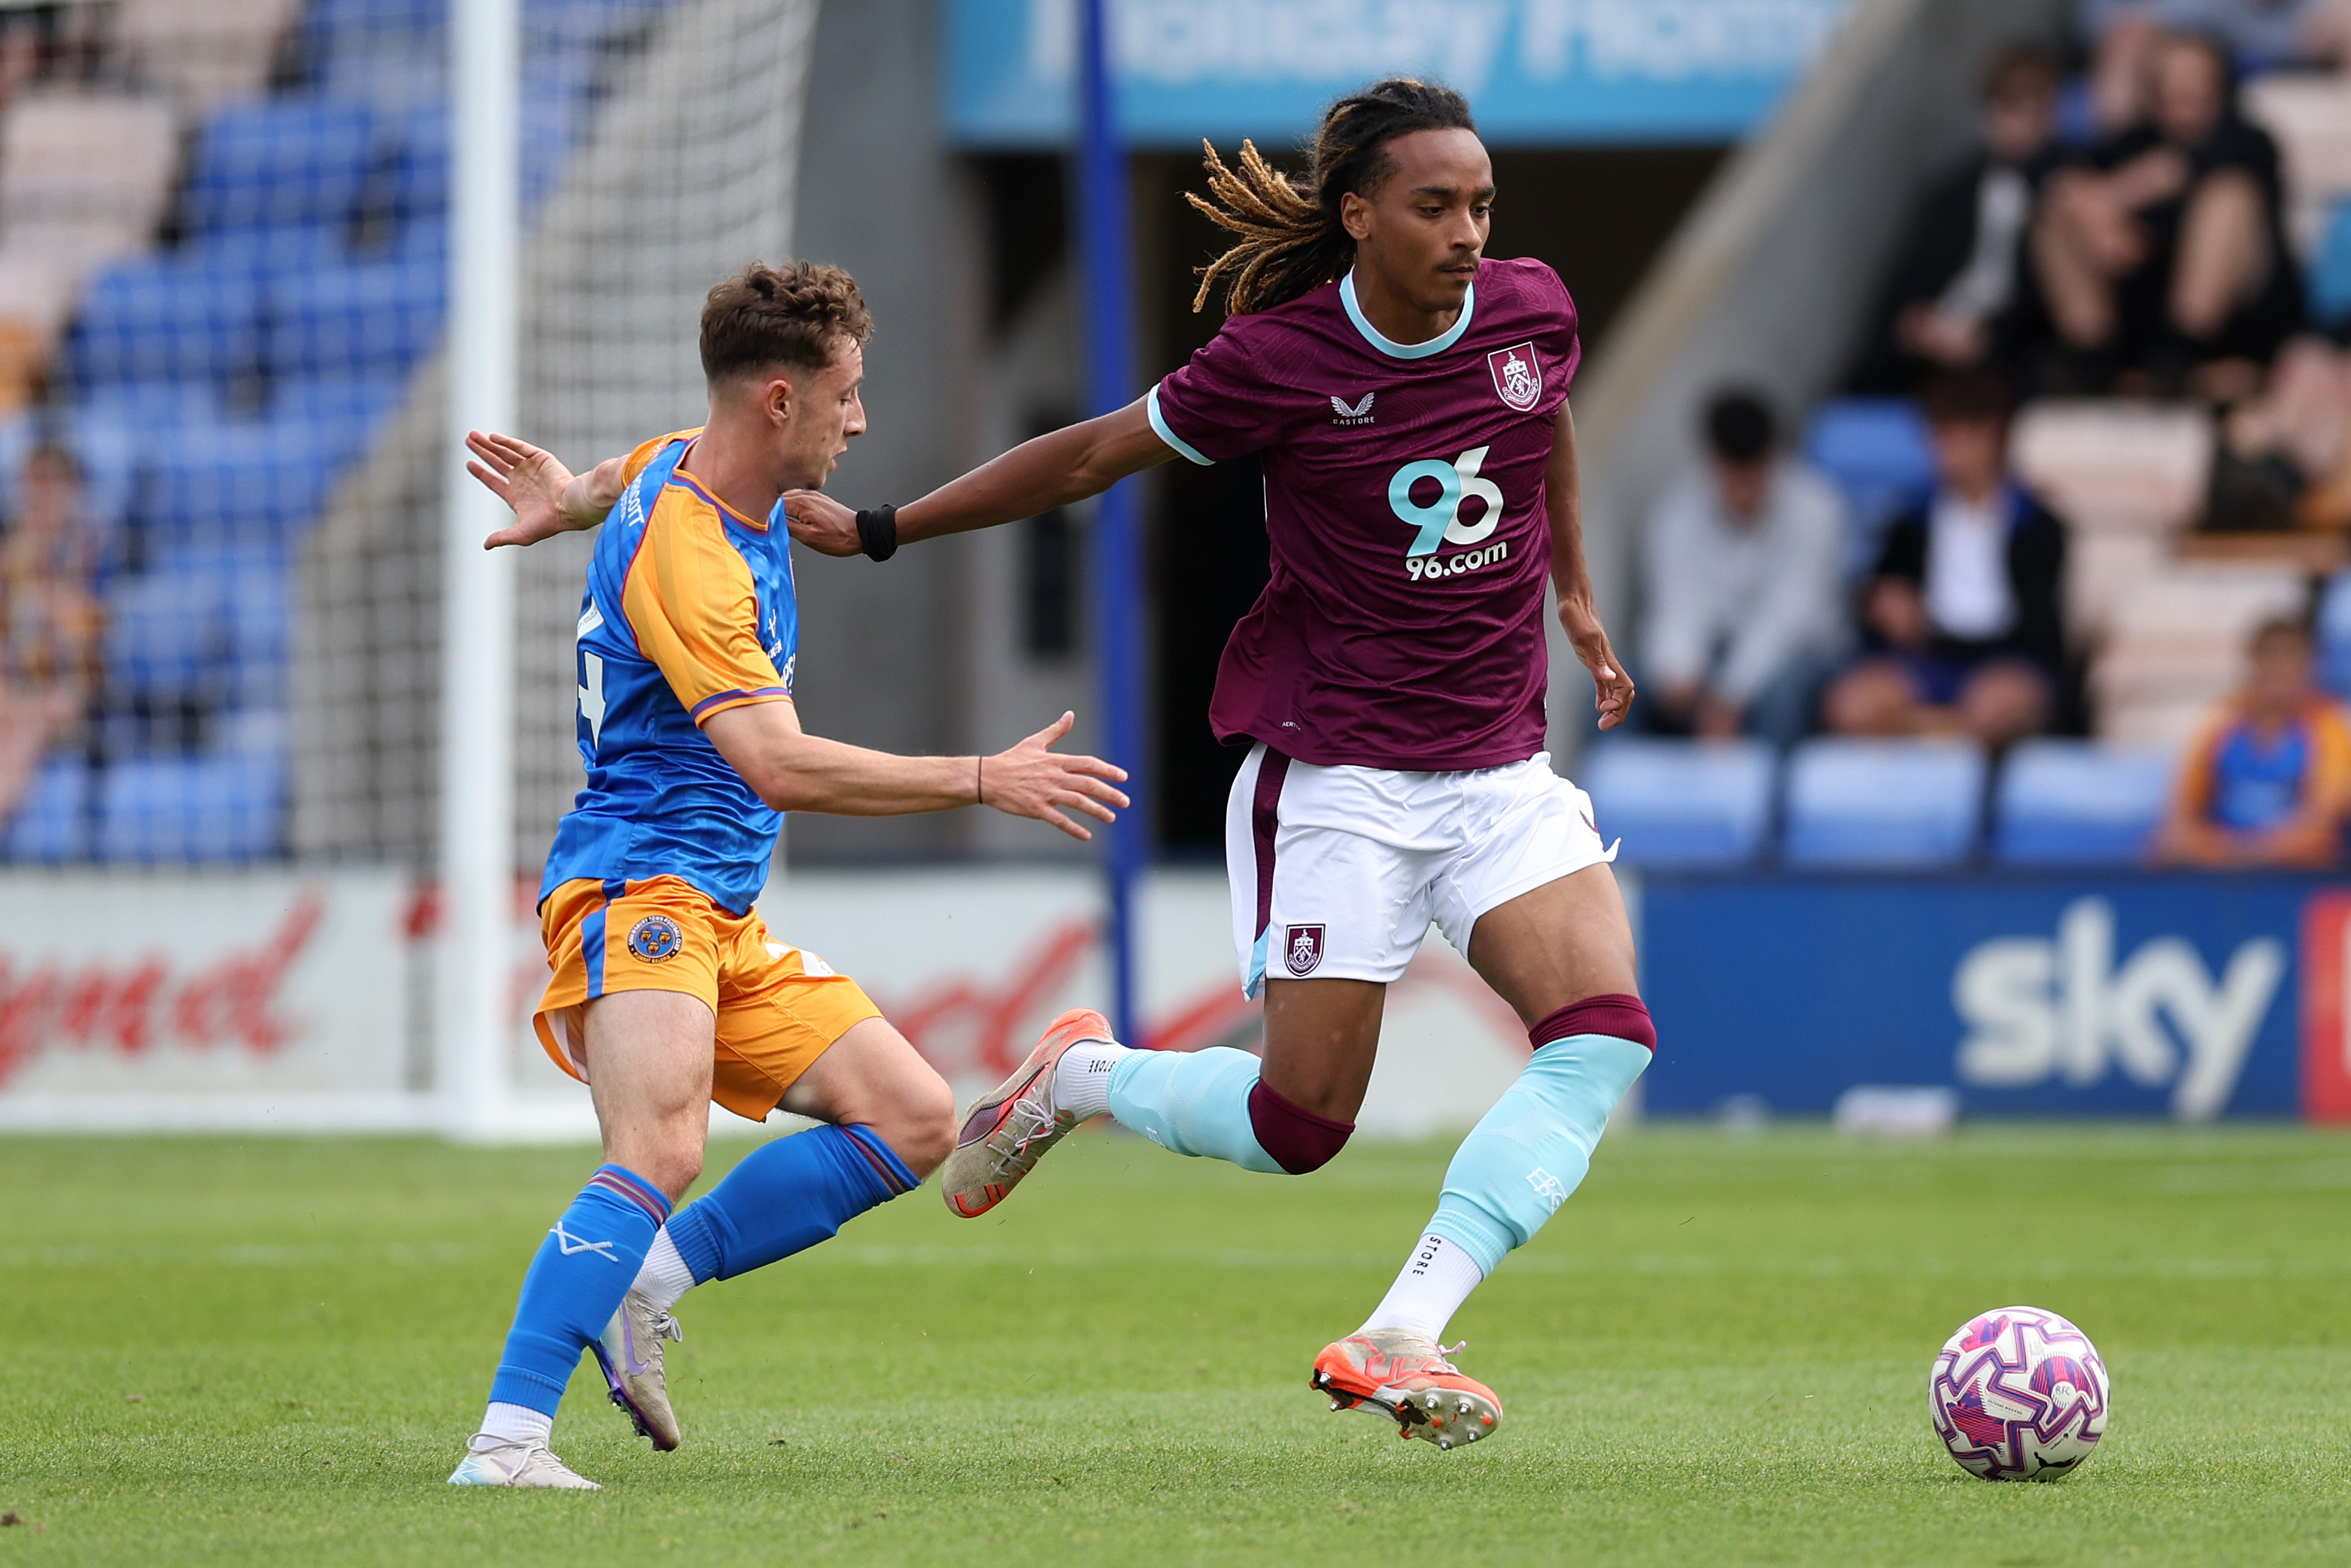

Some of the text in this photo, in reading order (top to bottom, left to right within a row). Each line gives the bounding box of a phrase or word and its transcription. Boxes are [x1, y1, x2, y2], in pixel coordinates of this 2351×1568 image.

[1333, 416, 1375, 425] CASTORE
[1388, 445, 1504, 558] 96
[1405, 541, 1508, 581] 96.com
[1952, 897, 2286, 1123] sky
[1412, 1236, 1441, 1276] STORE
